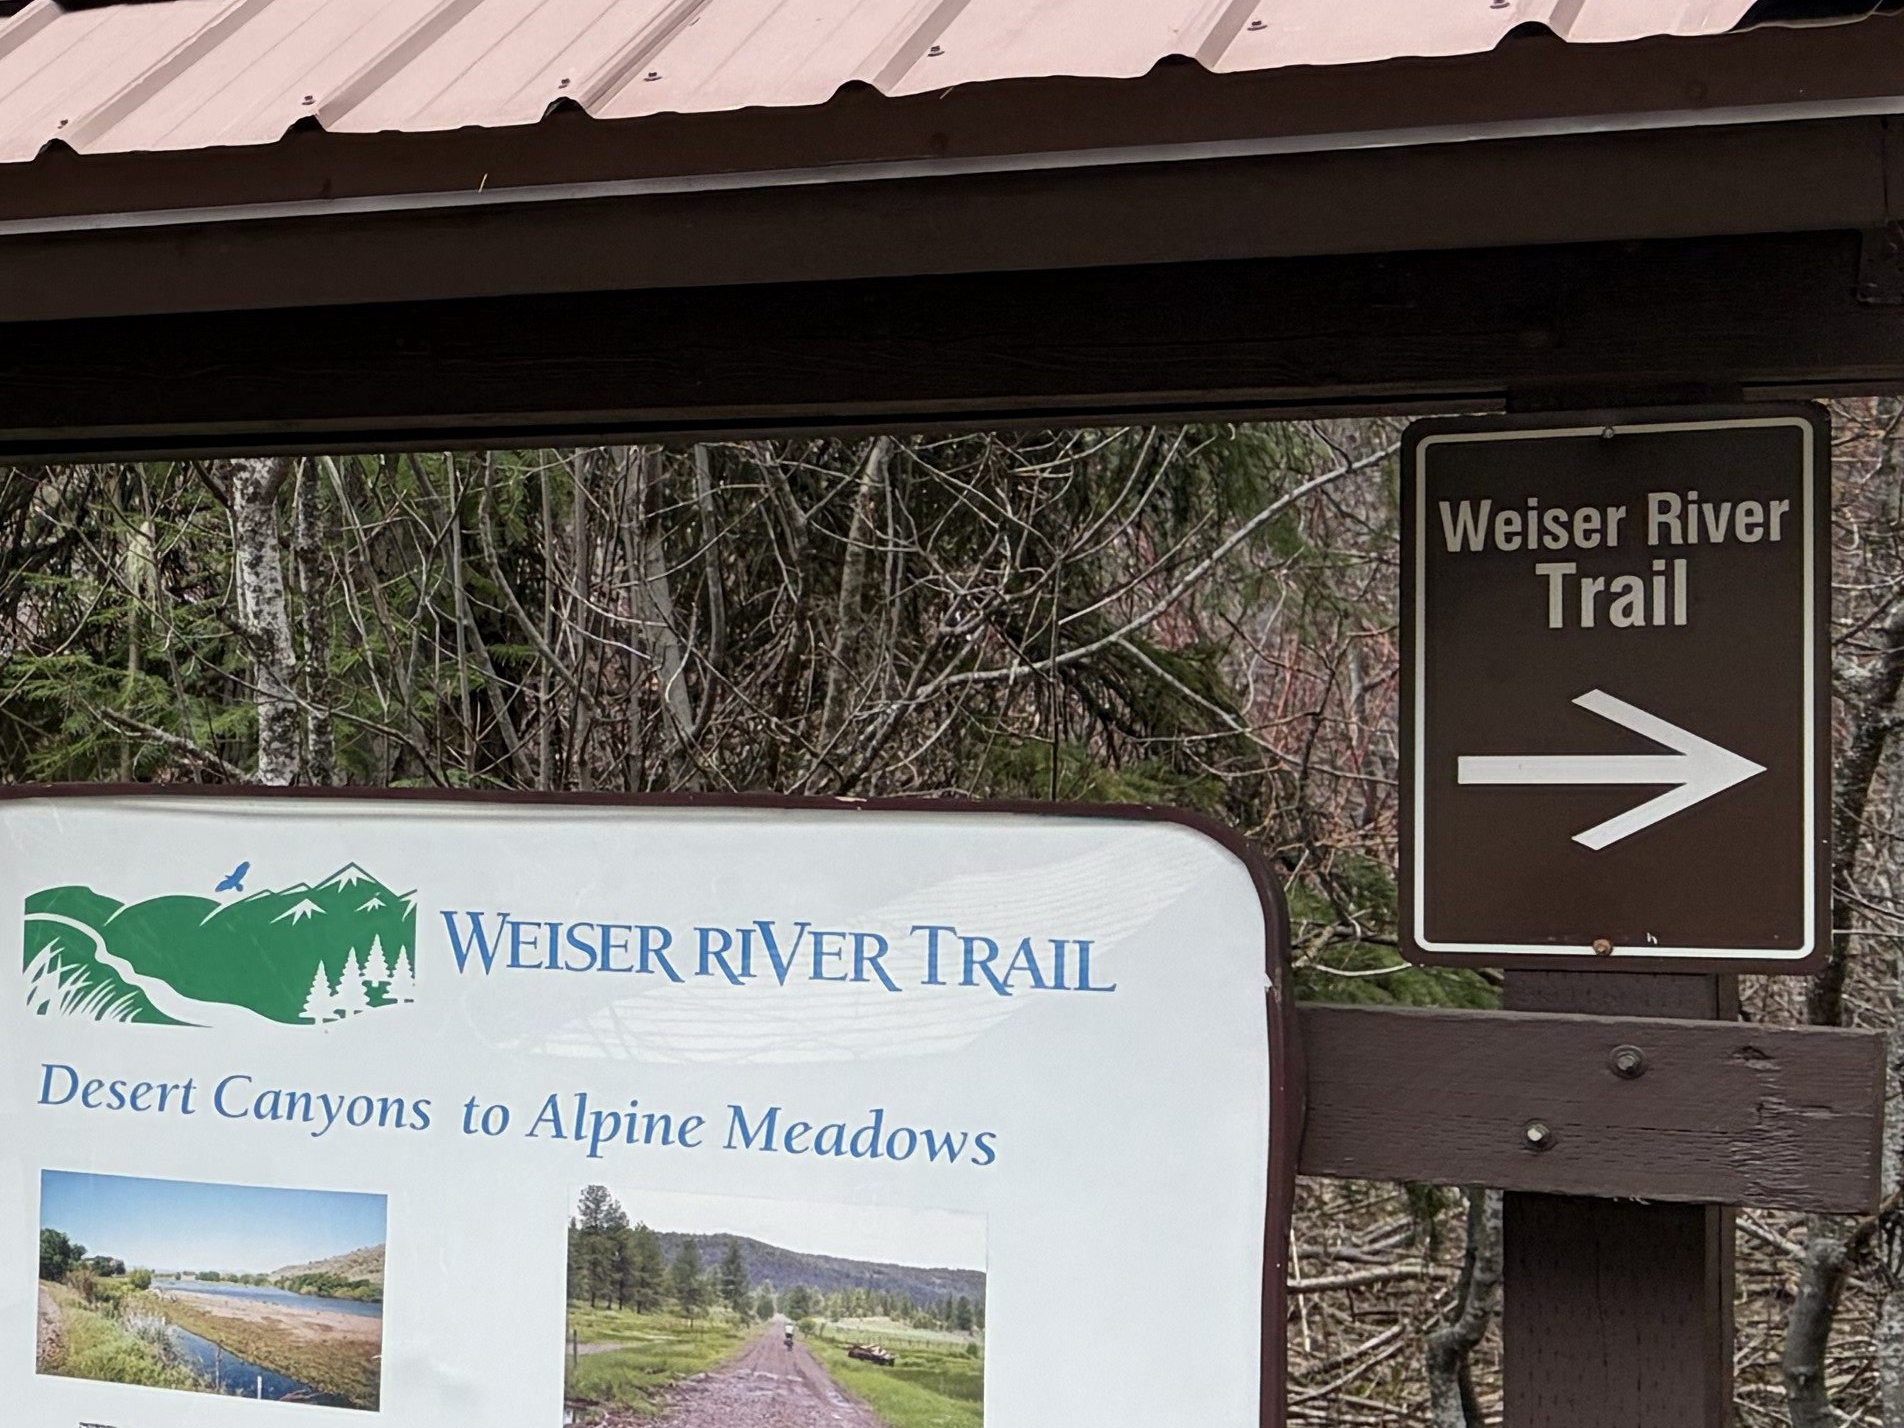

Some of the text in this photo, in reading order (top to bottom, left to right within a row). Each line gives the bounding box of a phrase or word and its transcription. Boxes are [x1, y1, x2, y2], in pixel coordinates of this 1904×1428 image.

[1439, 490, 1789, 551] Weiser River
[1535, 559, 1686, 627] Trail
[439, 910, 1116, 996] WEISER RIVER TRAIL
[37, 1063, 996, 1165] Desert Canyons to Alpine Meadows
